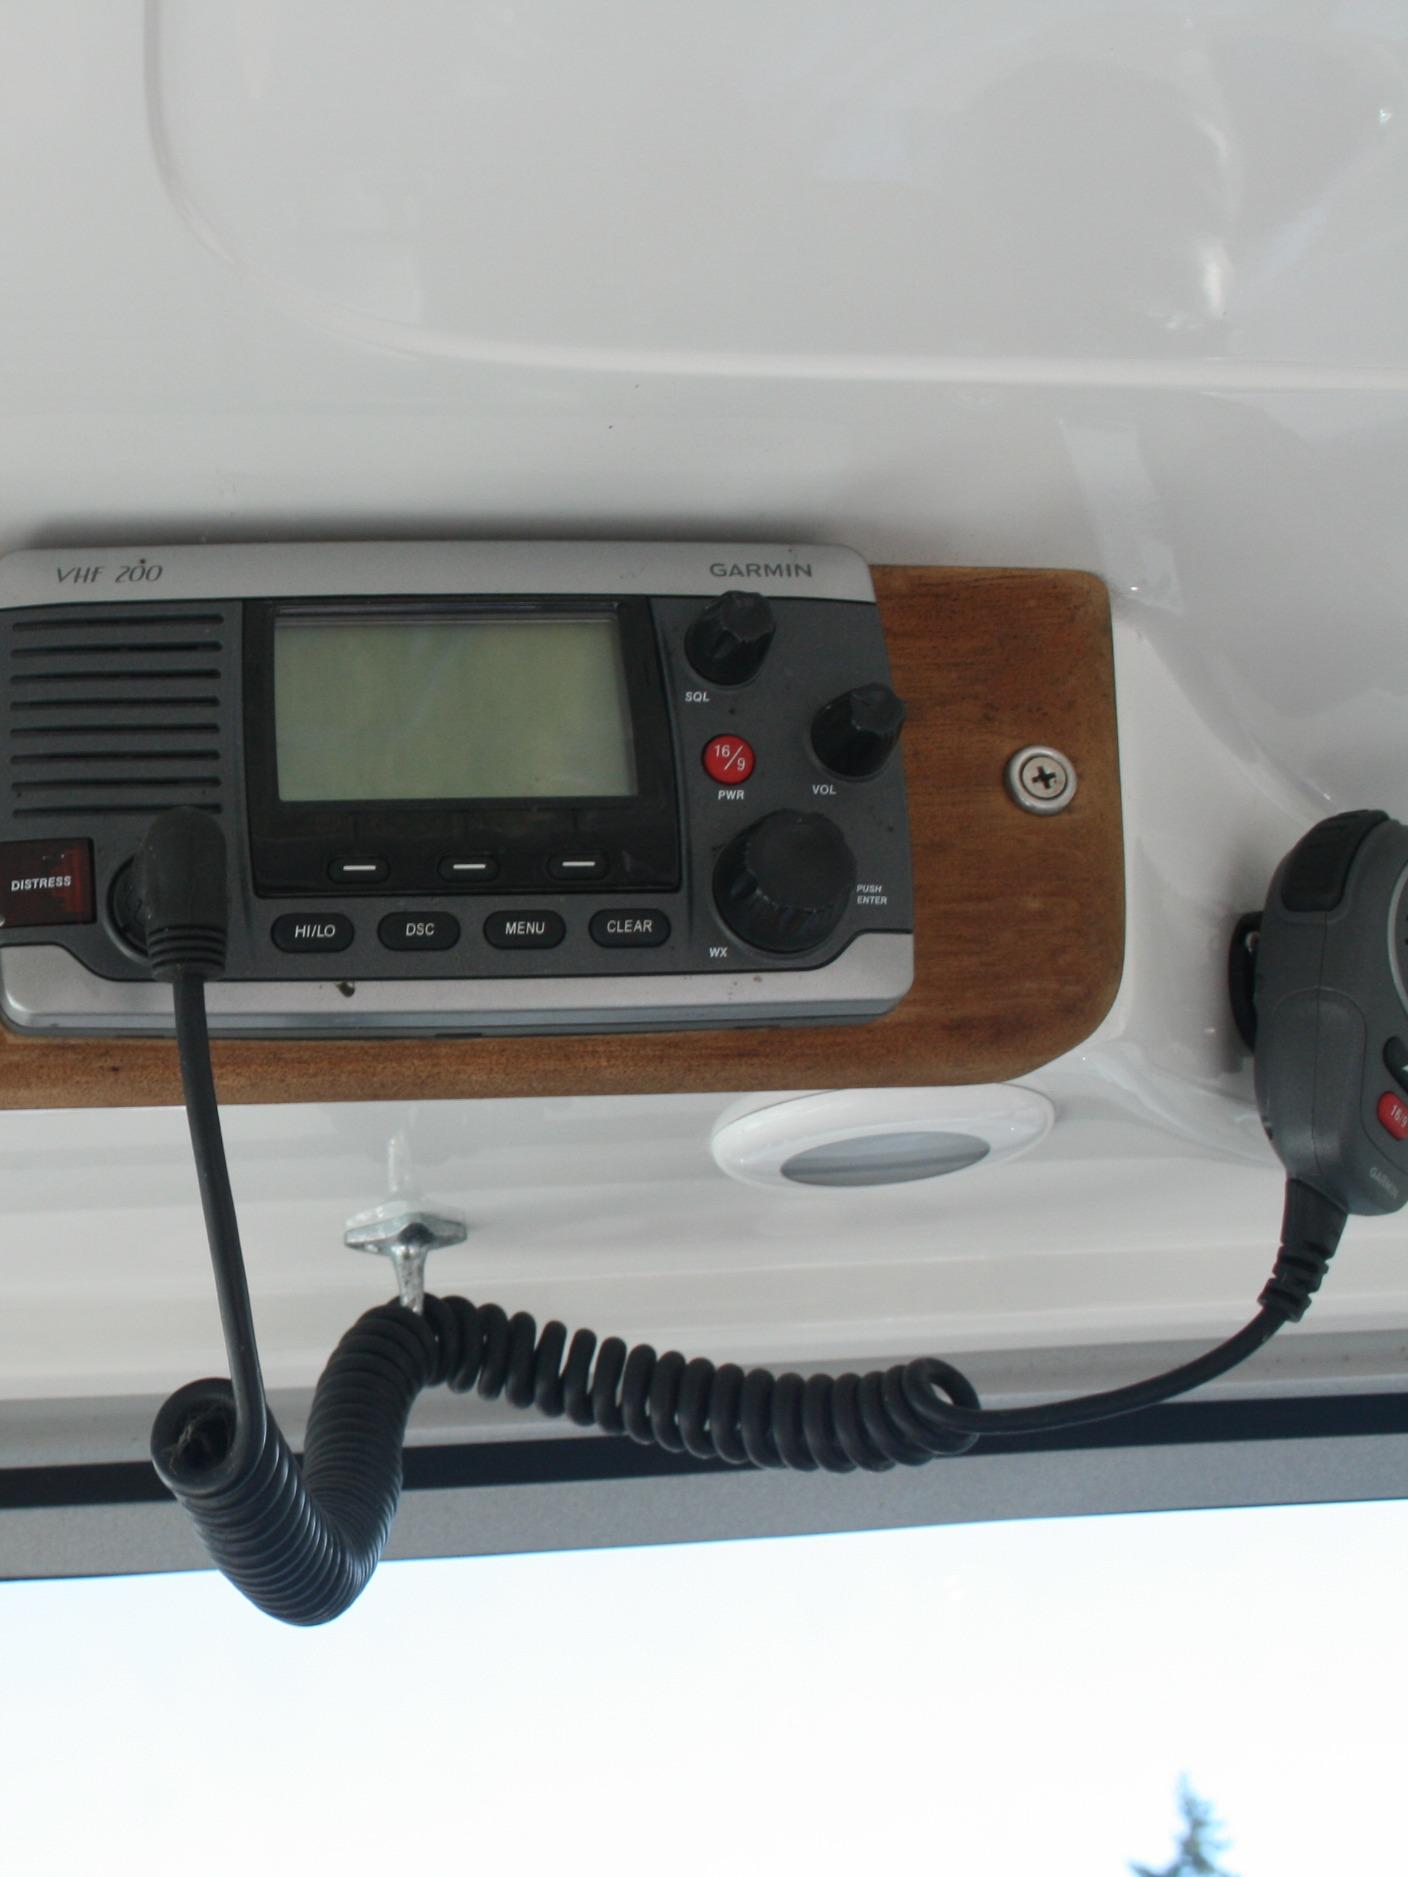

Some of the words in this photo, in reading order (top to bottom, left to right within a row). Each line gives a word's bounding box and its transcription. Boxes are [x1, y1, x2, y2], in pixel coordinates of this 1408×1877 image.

[55, 566, 106, 584] VHF
[114, 563, 163, 583] 200
[709, 562, 813, 578] GARMIN
[684, 691, 710, 703] SQL
[717, 789, 745, 801] PWR
[812, 784, 837, 796] VOL
[10, 874, 72, 892] DISTRESS
[856, 884, 882, 894] PUSH
[857, 895, 888, 905] ENTER
[294, 923, 337, 939] HI/LO
[405, 922, 435, 936] DSC
[505, 921, 546, 935] MENU
[606, 919, 654, 934] CLEAR
[709, 946, 728, 958] WX
